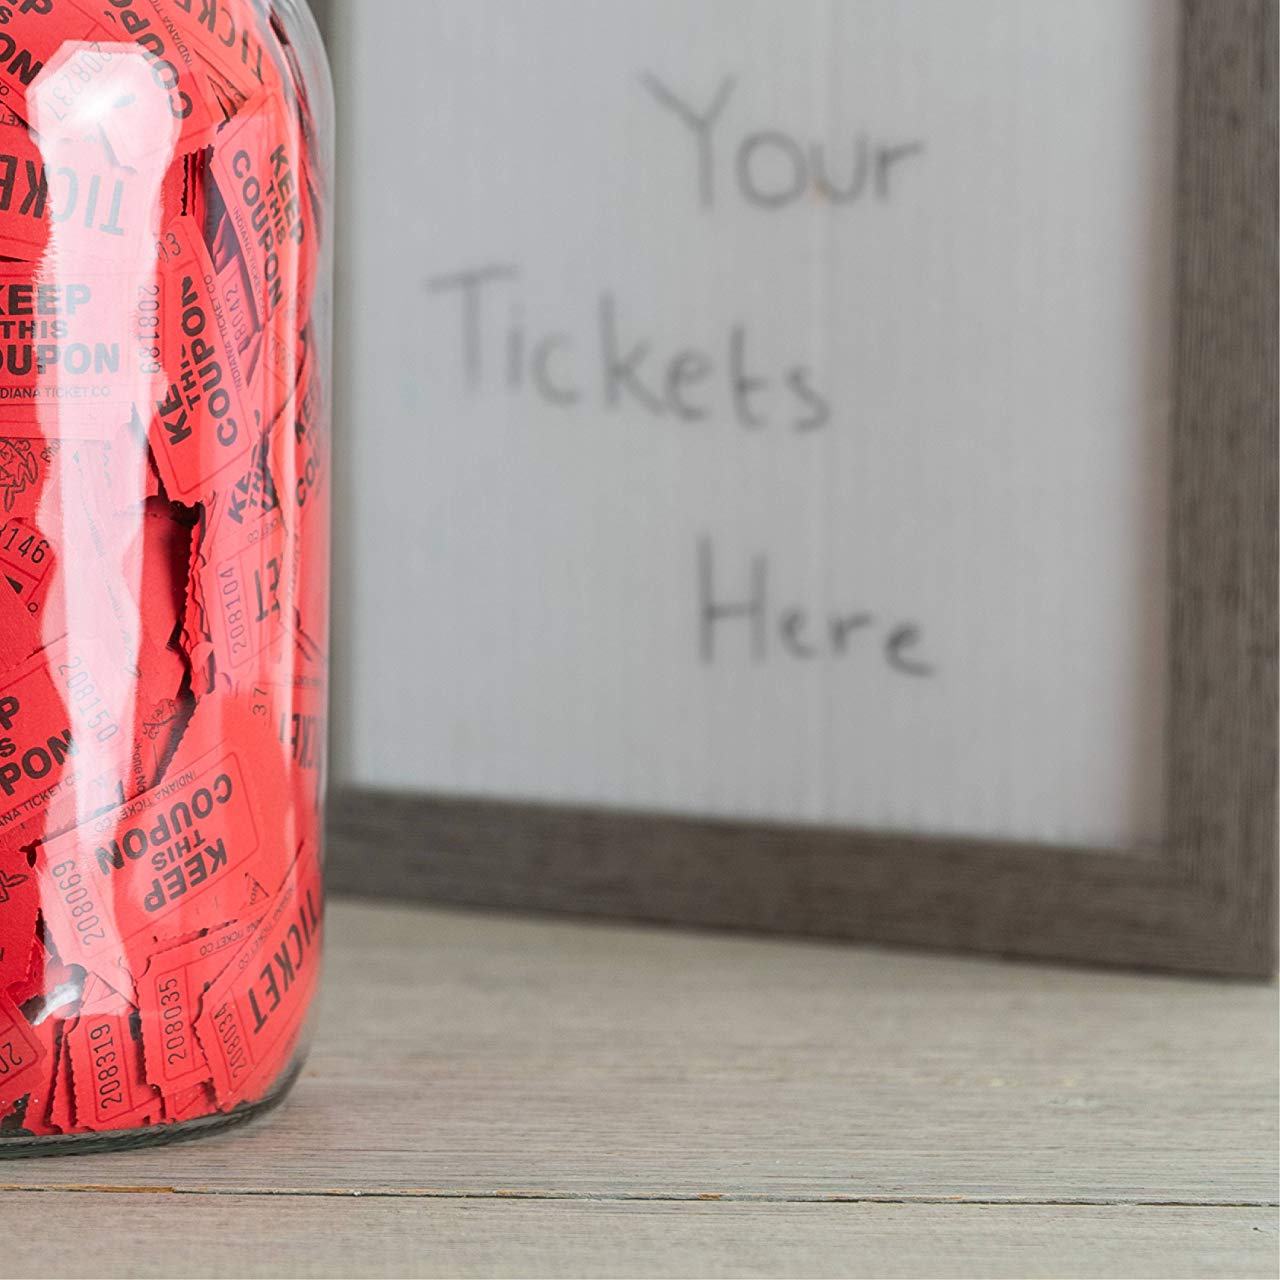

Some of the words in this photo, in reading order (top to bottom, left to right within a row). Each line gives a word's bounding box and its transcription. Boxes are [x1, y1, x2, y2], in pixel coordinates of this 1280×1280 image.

[637, 72, 926, 212] Your
[232, 149, 283, 309] COUPON
[266, 180, 286, 246] THIS
[270, 144, 305, 246] KEEP
[137, 285, 161, 375] 208189
[181, 276, 238, 447] COUPON
[210, 294, 231, 342] TICKET
[424, 263, 832, 436] Tickets
[44, 386, 89, 398] TICKET
[225, 344, 242, 392] INDIANA
[698, 532, 934, 677] Here
[58, 656, 119, 744] 208150
[23, 781, 63, 811] TICKET
[96, 773, 233, 875] COUPON
[154, 771, 197, 799] INDIANA
[144, 838, 228, 912] KEEP
[152, 830, 206, 871] THIS
[51, 859, 106, 947] 208069
[248, 889, 319, 1035] TICKET
[159, 978, 186, 1065] 208035
[90, 1023, 122, 1110] 208319
